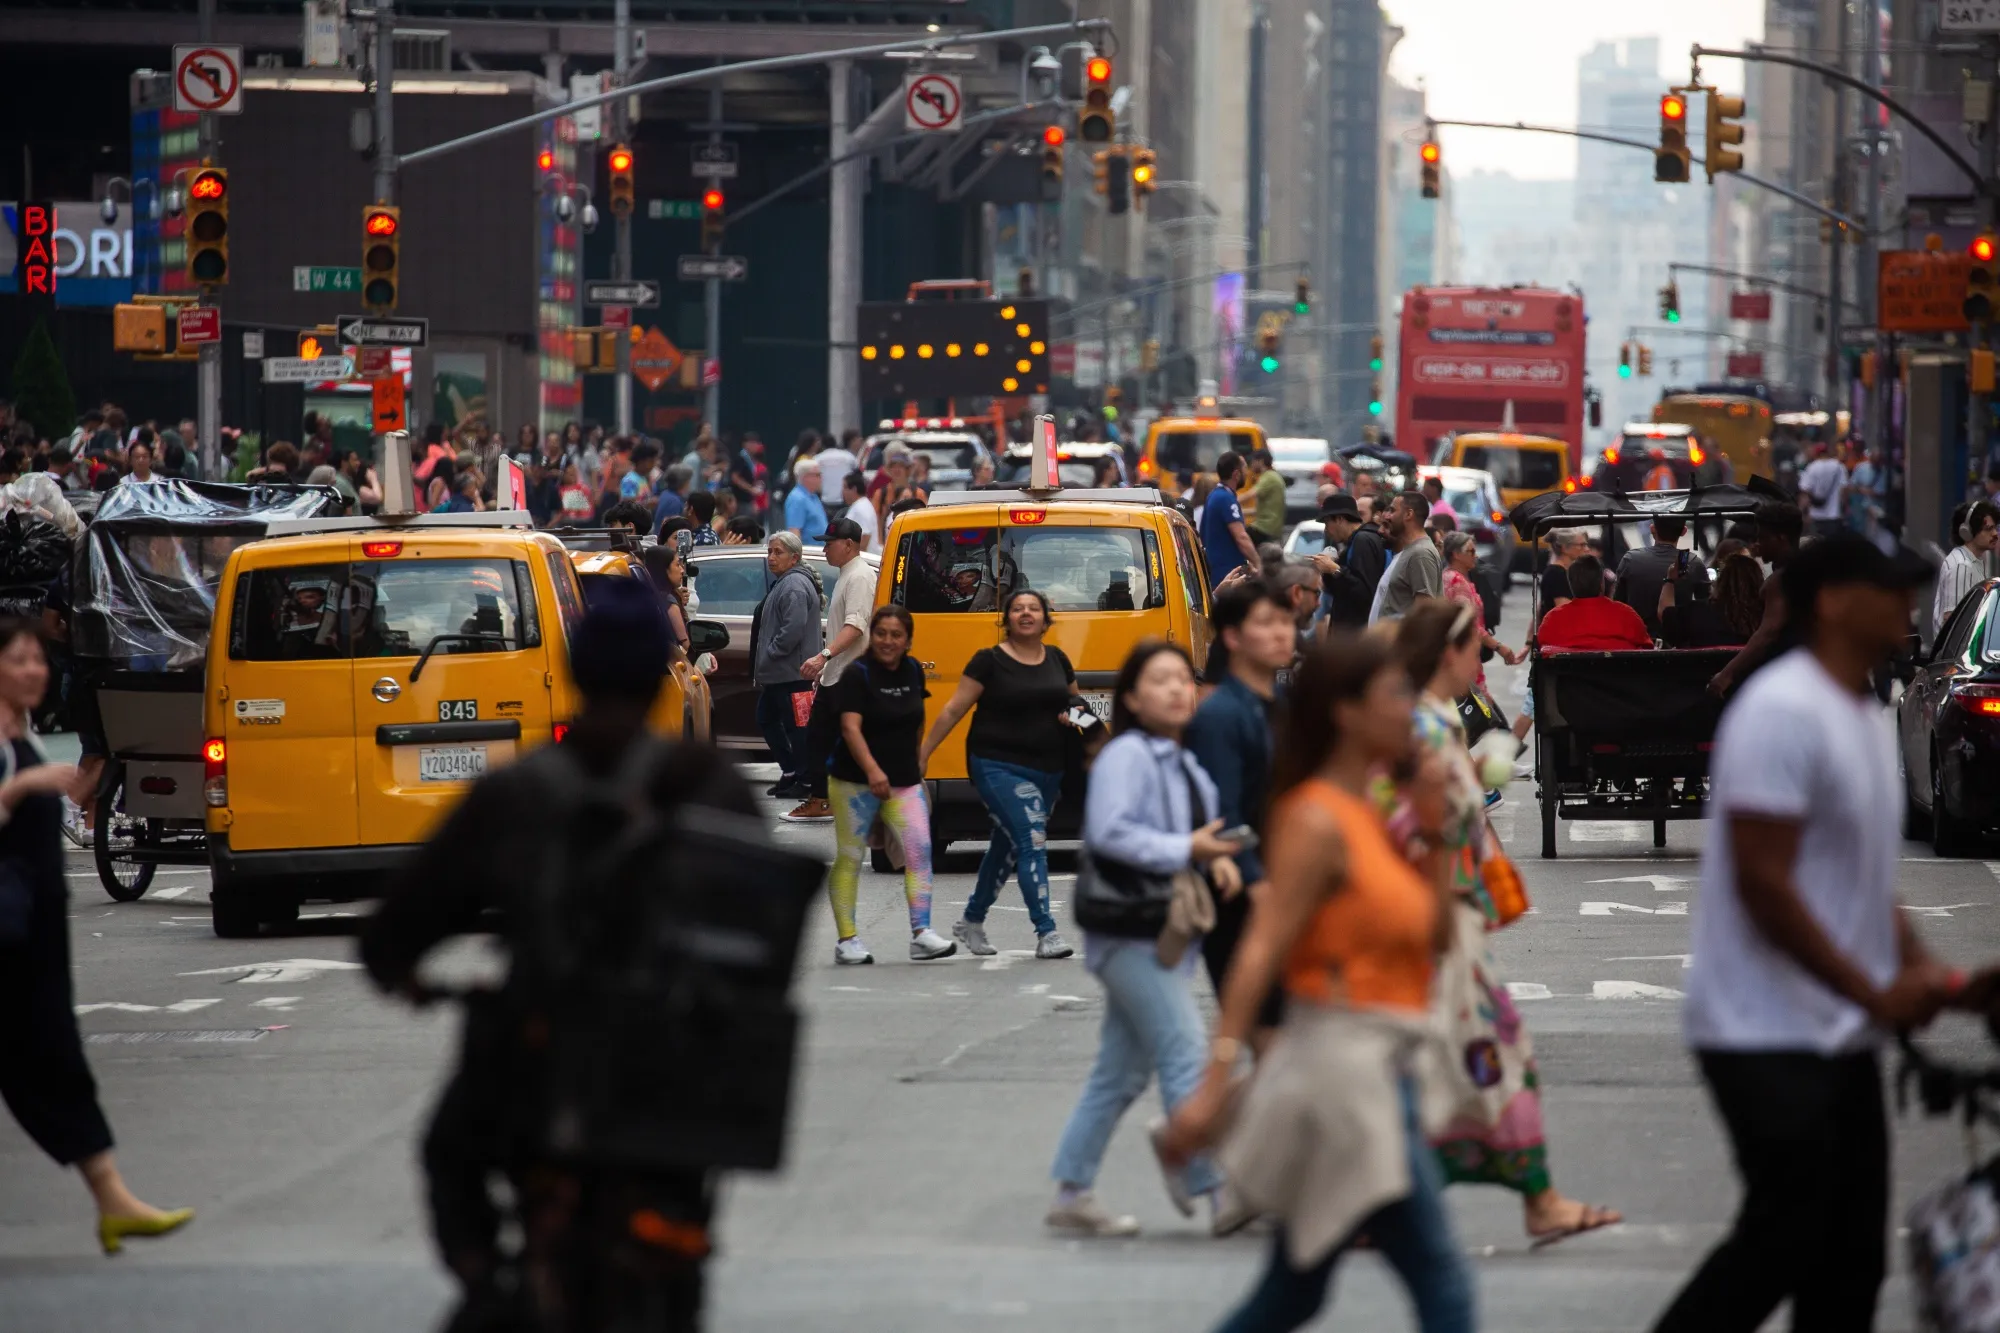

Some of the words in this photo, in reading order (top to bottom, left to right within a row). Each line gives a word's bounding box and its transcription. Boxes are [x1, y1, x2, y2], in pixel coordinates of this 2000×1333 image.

[1946, 7, 1982, 23] SAT
[25, 206, 48, 294] BAR
[313, 269, 327, 288] W
[333, 269, 352, 289] 44
[351, 325, 377, 338] ONE
[389, 329, 417, 340] WAY
[440, 701, 476, 720] 845
[425, 755, 482, 774] Y203484C
